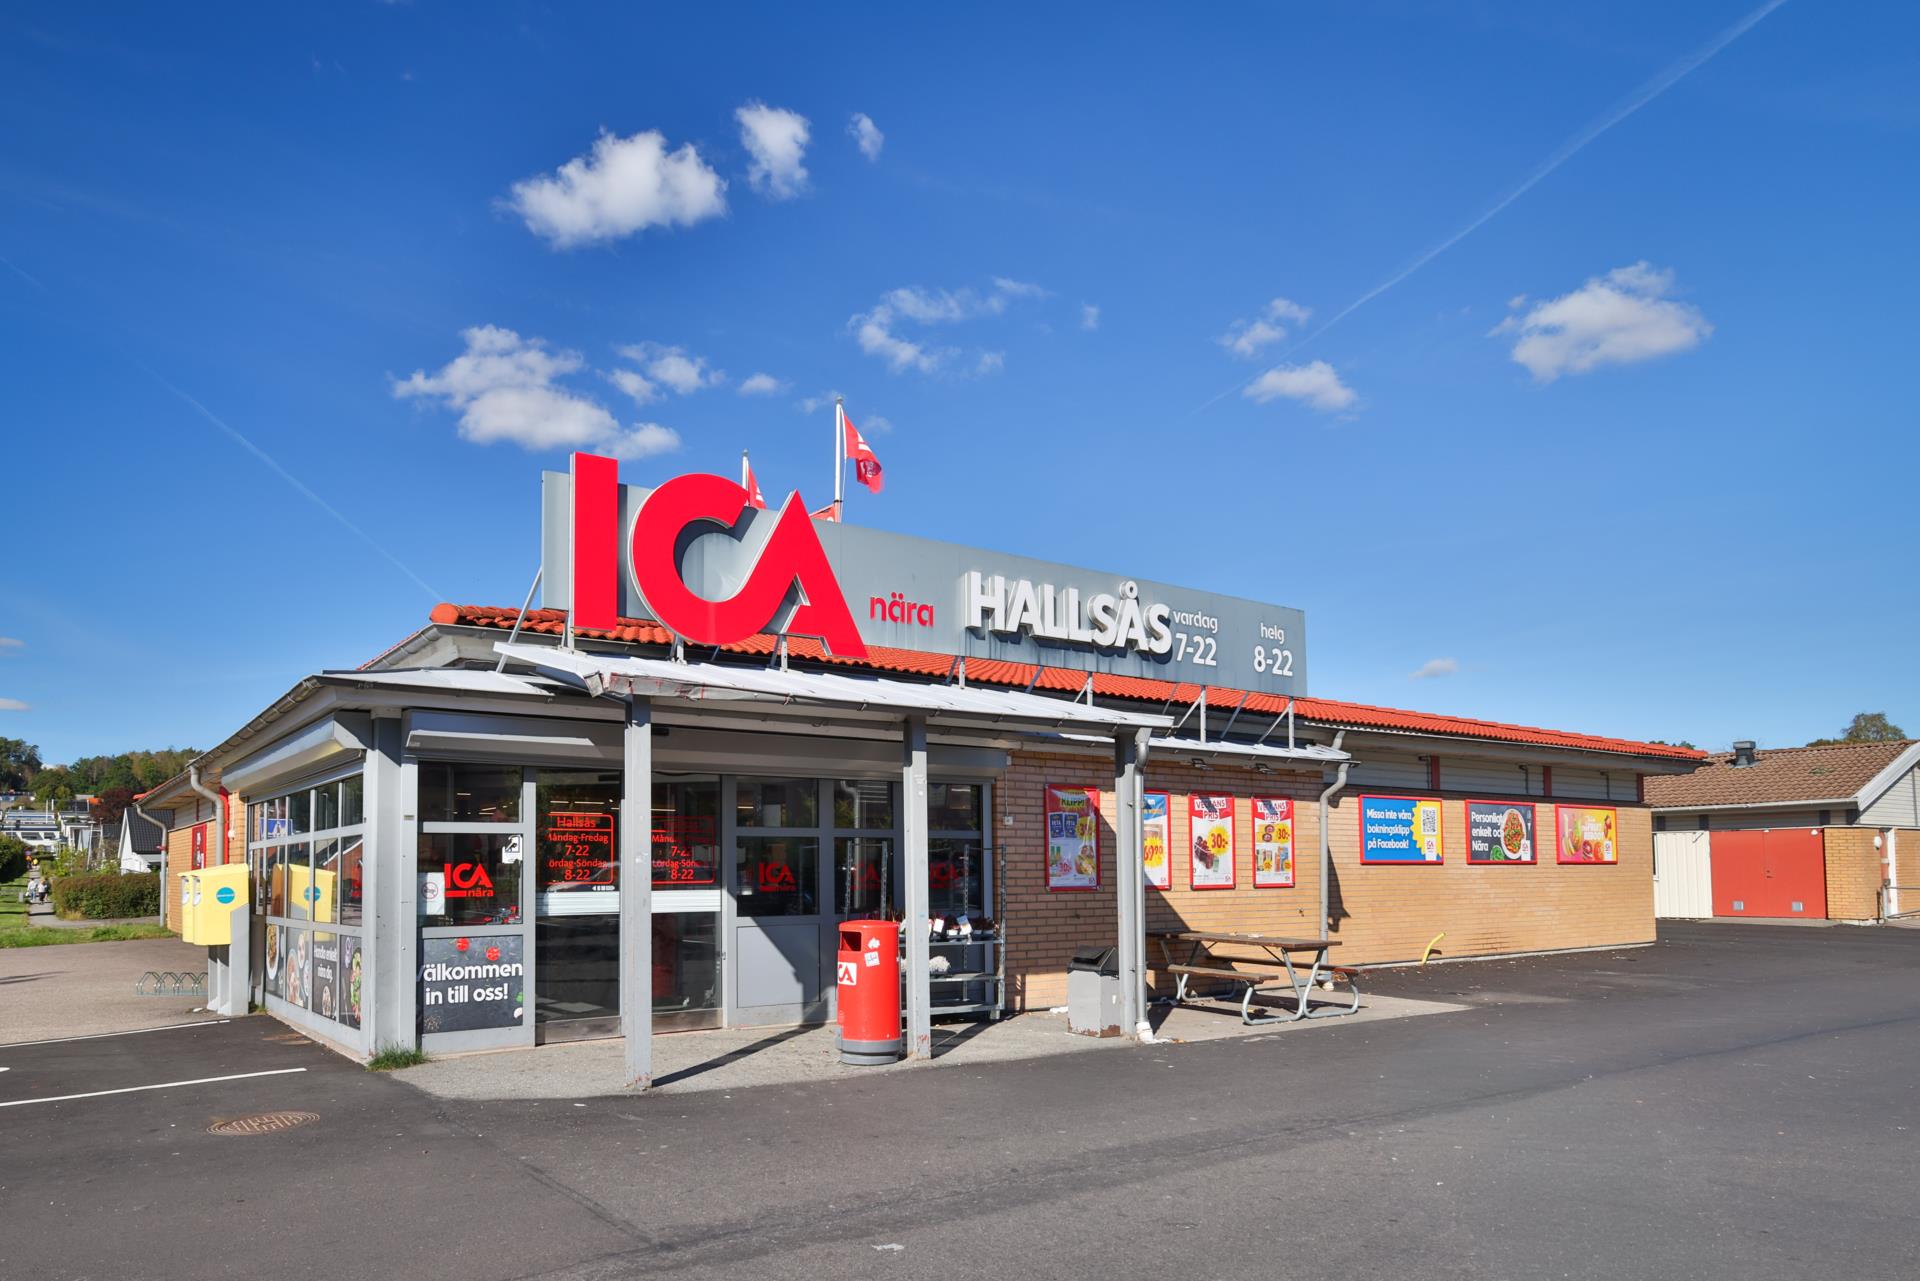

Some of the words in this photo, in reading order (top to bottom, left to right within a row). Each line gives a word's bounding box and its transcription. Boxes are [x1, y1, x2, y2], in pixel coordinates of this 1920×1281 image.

[570, 451, 868, 659] ICA
[870, 592, 935, 628] nära
[965, 571, 1174, 655] HALLSÅS
[1173, 610, 1219, 634] vardag
[1260, 622, 1285, 645] helg
[1176, 633, 1217, 667] 7-22
[1253, 645, 1294, 678] 8-22
[1204, 811, 1219, 820] PRIS
[1367, 808, 1385, 819] Missa
[1385, 809, 1397, 819] inte
[1398, 809, 1412, 820] våra
[557, 816, 597, 828] Hallsås
[1471, 825, 1492, 837] enkelt
[1492, 829, 1502, 837] oc
[548, 832, 609, 844] åndag-Fredag
[1367, 838, 1377, 850] på
[1377, 838, 1409, 849] Facebook!
[565, 844, 590, 856] 7-22
[1472, 840, 1489, 851] Nära
[548, 859, 608, 870] ördag-Söndag
[444, 863, 493, 889] ICA
[564, 869, 591, 881] 8-22
[671, 868, 694, 880] 8-22
[760, 863, 796, 883] ICA
[467, 888, 494, 897] nära
[425, 987, 442, 1005] in
[448, 984, 468, 1004] till
[473, 983, 508, 1002] oss!
